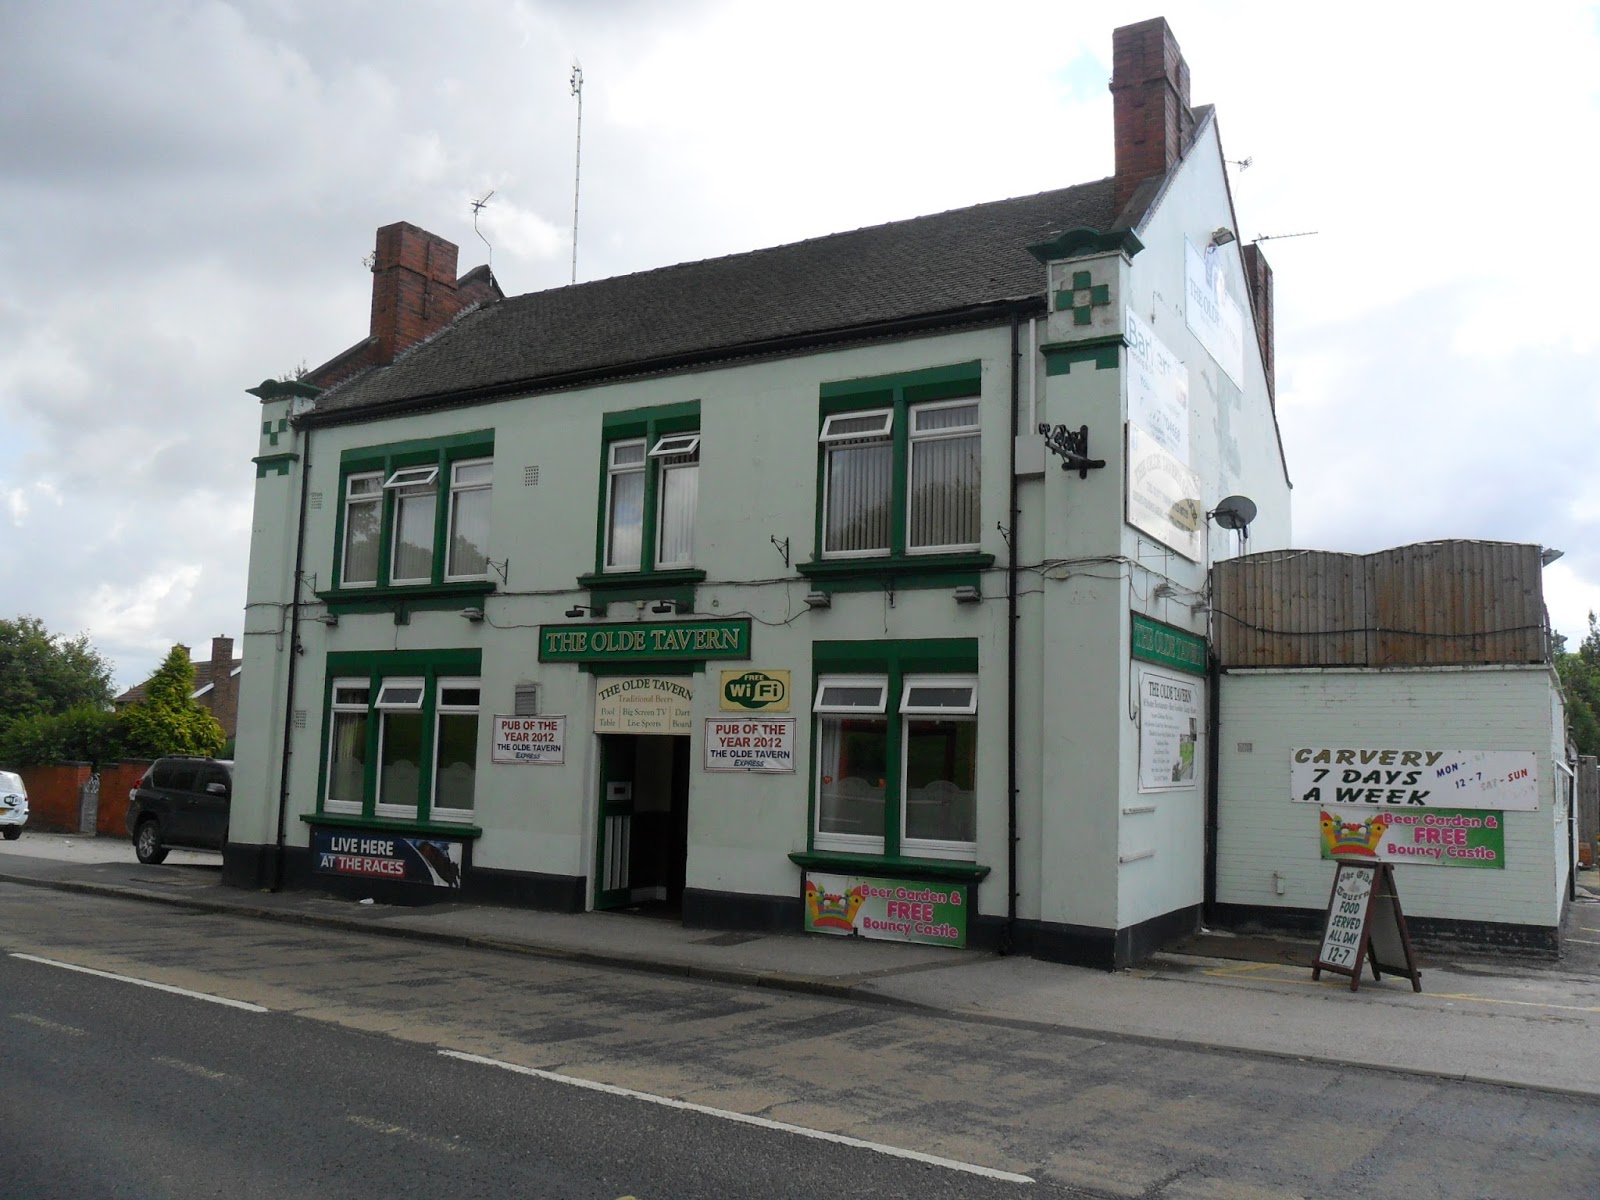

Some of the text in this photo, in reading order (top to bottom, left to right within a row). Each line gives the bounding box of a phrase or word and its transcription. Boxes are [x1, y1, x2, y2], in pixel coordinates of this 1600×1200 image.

[546, 628, 740, 652] THE OLDE TAVERN
[1135, 622, 1154, 651] THE
[1175, 637, 1204, 668] TAVER
[598, 678, 694, 701] THE OLDE TAVERN
[1148, 680, 1159, 698] THE
[1159, 683, 1174, 700] OLDE
[619, 694, 673, 703] Traditional Beers
[601, 707, 615, 716] Pool
[622, 708, 667, 716] Big Screen TV
[675, 709, 690, 717] Dart
[501, 720, 558, 731] PUB OF THE
[600, 719, 616, 727] Table
[672, 719, 692, 728] Board
[716, 724, 786, 735] PUB OF THE
[504, 732, 555, 742] YEAR 2012
[719, 736, 782, 748] YEAR 2012
[497, 743, 561, 752] THE OLDE TAVERN
[710, 749, 790, 759] THE OLDE TAVERN
[733, 759, 765, 767] EXPRESS
[1294, 748, 1443, 768] CARVERY
[1312, 768, 1423, 786] 7 DAYS
[1436, 762, 1459, 779] MON
[1507, 768, 1529, 783] SUN
[1302, 787, 1432, 806] A WEEK
[1382, 813, 1499, 829] Beer Garden &
[1413, 827, 1469, 846] FREE
[331, 836, 394, 856] LIVE HERE
[1387, 843, 1496, 860] Bouncy Castle
[320, 855, 404, 875] AT THE RACES
[860, 884, 963, 905] Beer Garden &
[1336, 885, 1370, 901] Tavern
[886, 901, 934, 923] FREE
[1339, 901, 1360, 915] FOOD
[862, 917, 960, 939] Bouncy Castle
[1331, 914, 1361, 930] SERVED
[1328, 929, 1359, 946] ALL DAY
